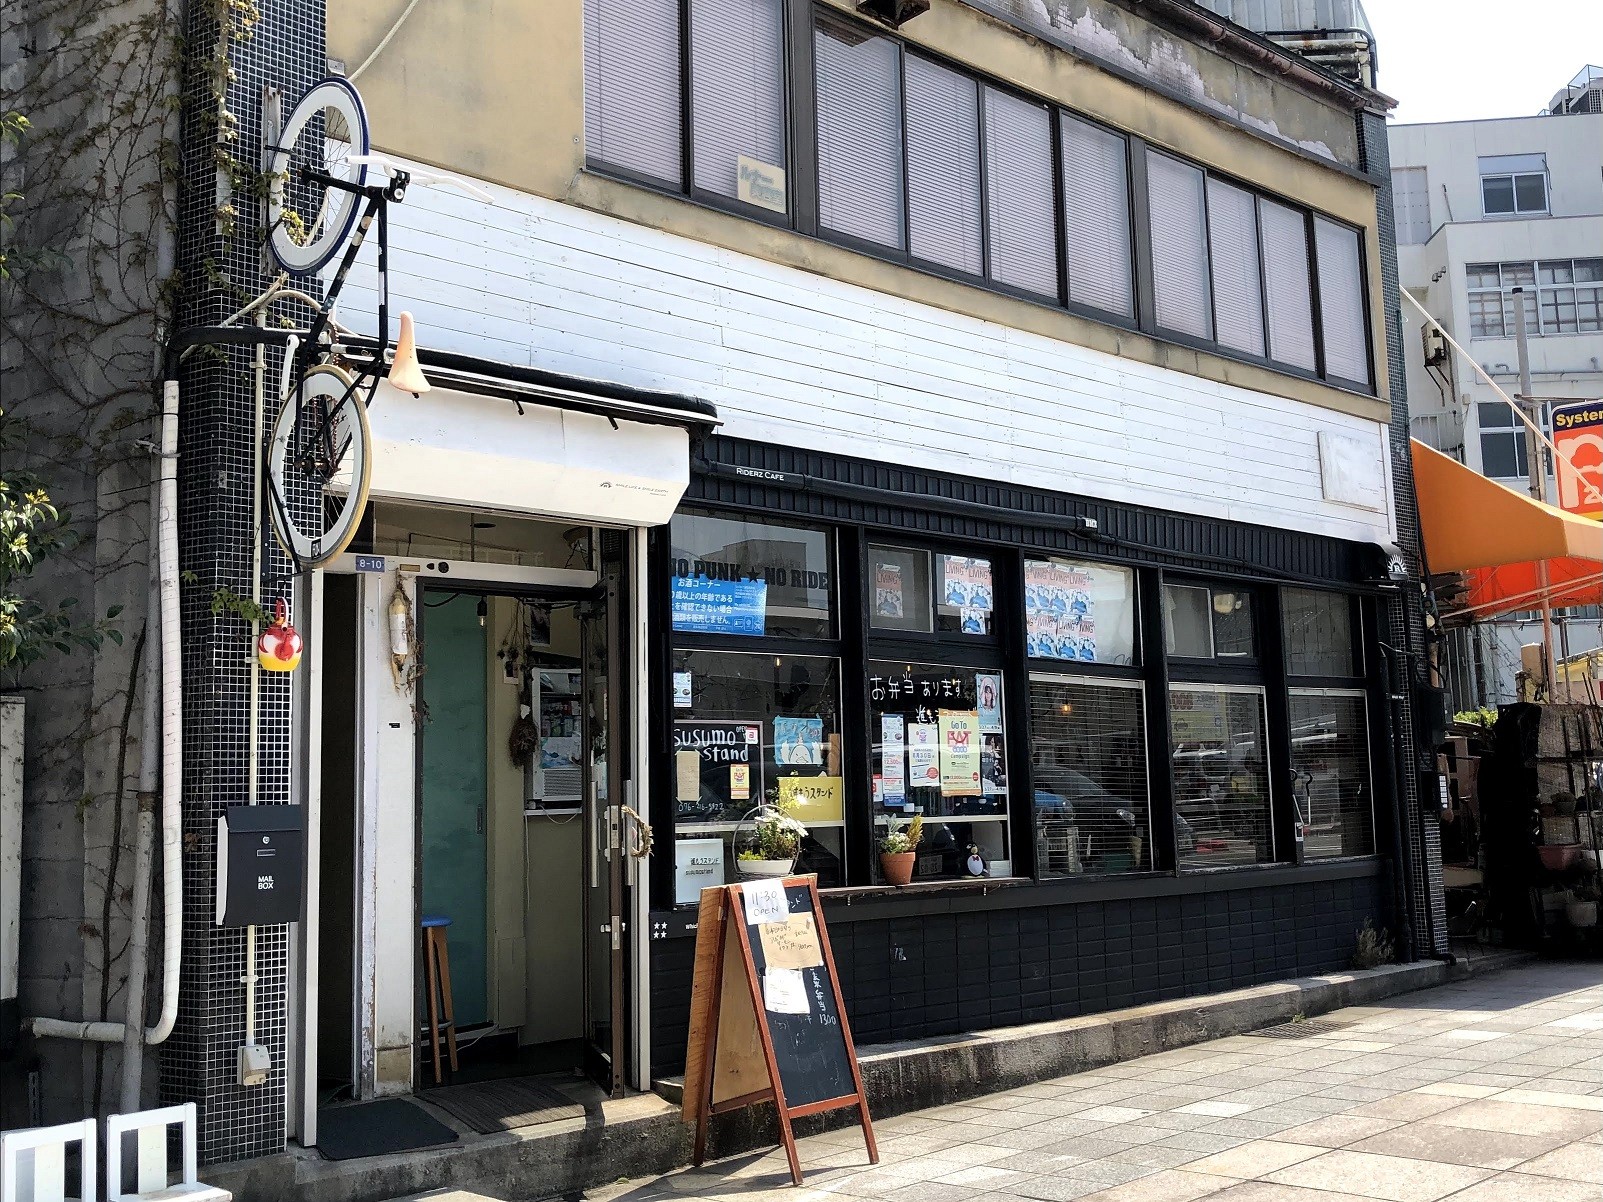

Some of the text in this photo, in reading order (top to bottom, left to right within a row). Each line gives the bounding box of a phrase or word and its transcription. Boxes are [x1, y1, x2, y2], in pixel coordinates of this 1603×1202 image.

[736, 468, 785, 481] RIDERZ CAFE
[359, 559, 382, 569] 8-10
[693, 560, 742, 583] PUNK
[764, 566, 787, 587] NO
[703, 743, 749, 762] stand
[258, 875, 274, 883] MAIL
[258, 882, 274, 890] BOX
[754, 906, 779, 917] OPEN
[819, 1013, 837, 1026] 1300
